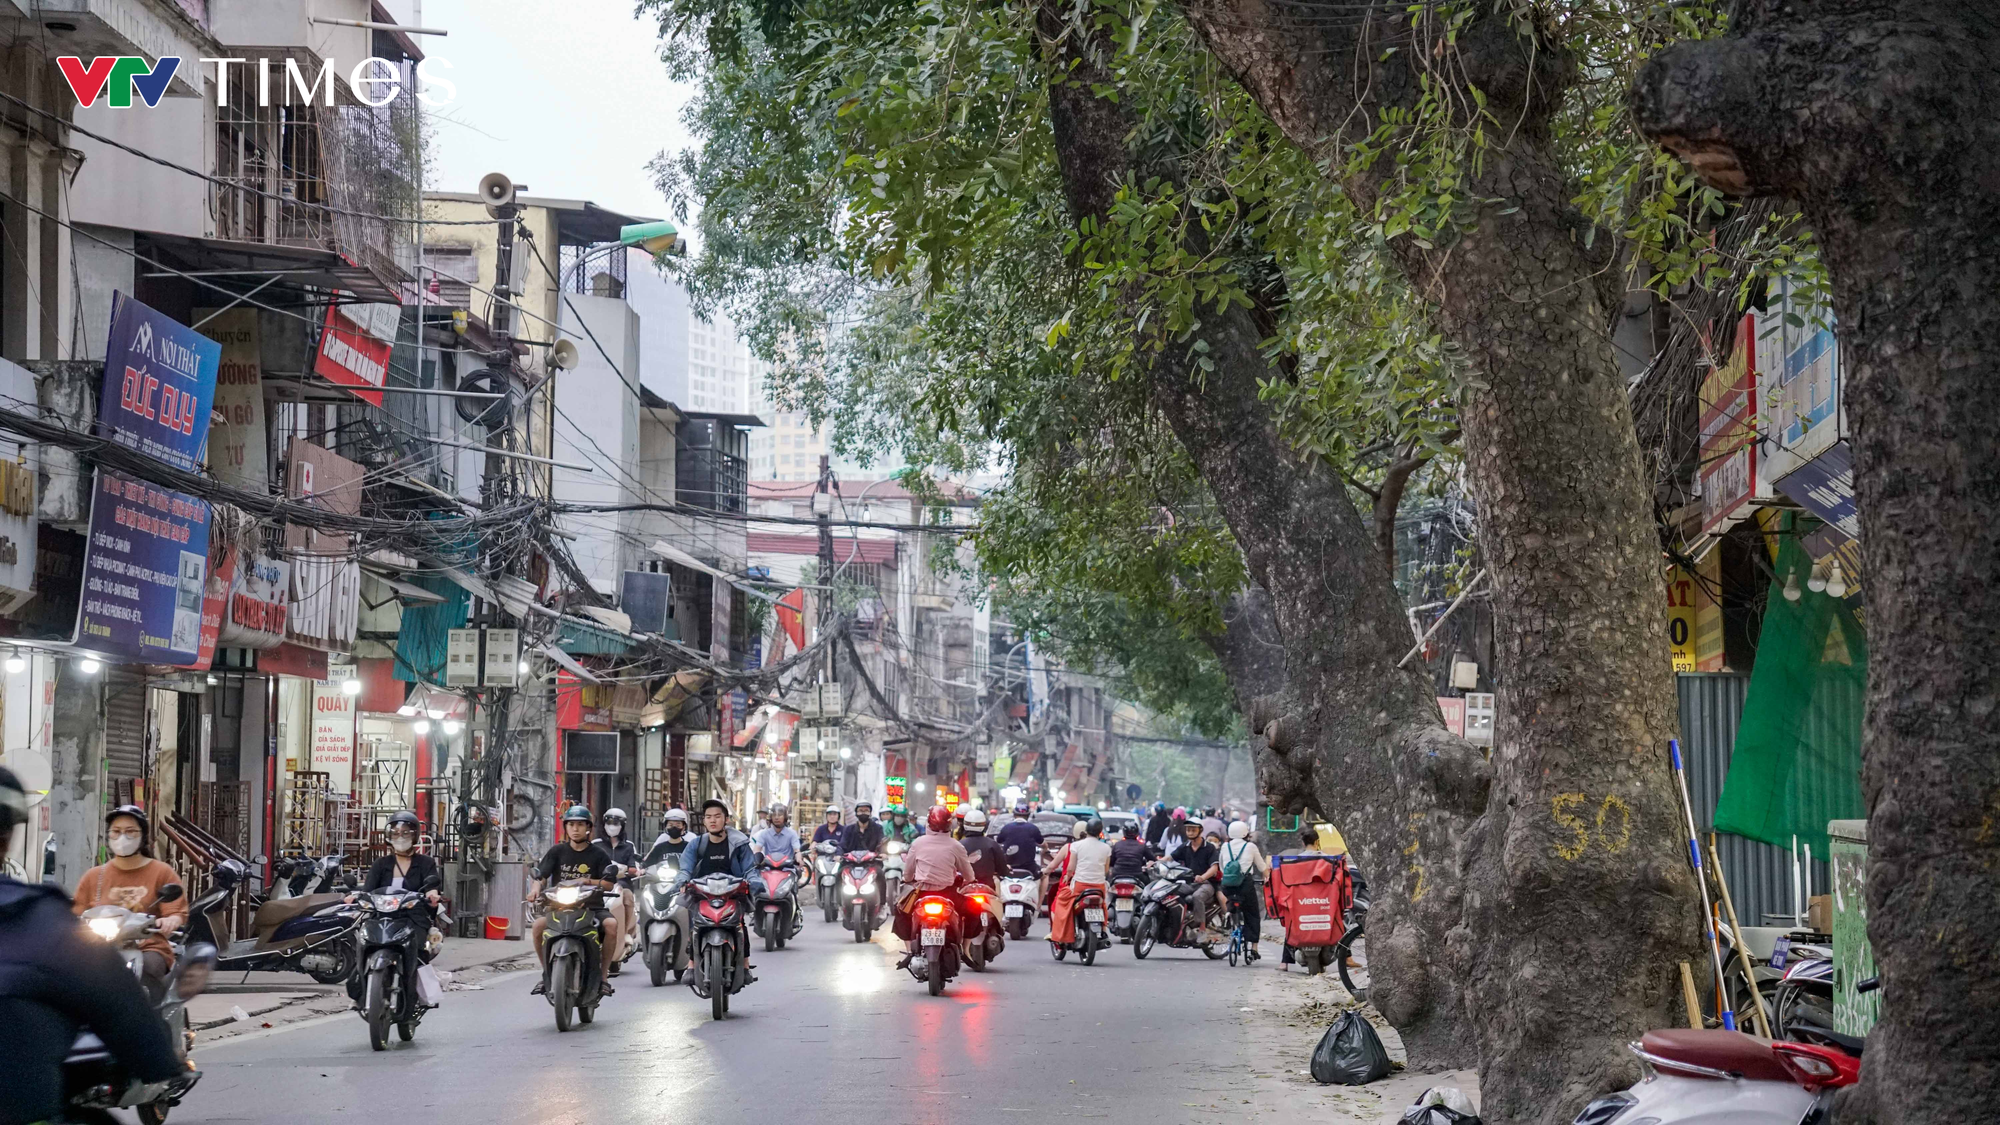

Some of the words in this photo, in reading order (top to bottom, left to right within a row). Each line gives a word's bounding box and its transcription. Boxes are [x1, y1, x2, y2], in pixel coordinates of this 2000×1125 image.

[175, 343, 201, 378] THẤT
[121, 365, 159, 420] ĐỨC
[159, 382, 197, 437] DUY
[331, 666, 347, 676] THẤT
[1552, 793, 1630, 860] 50
[1298, 897, 1331, 906] viettel
